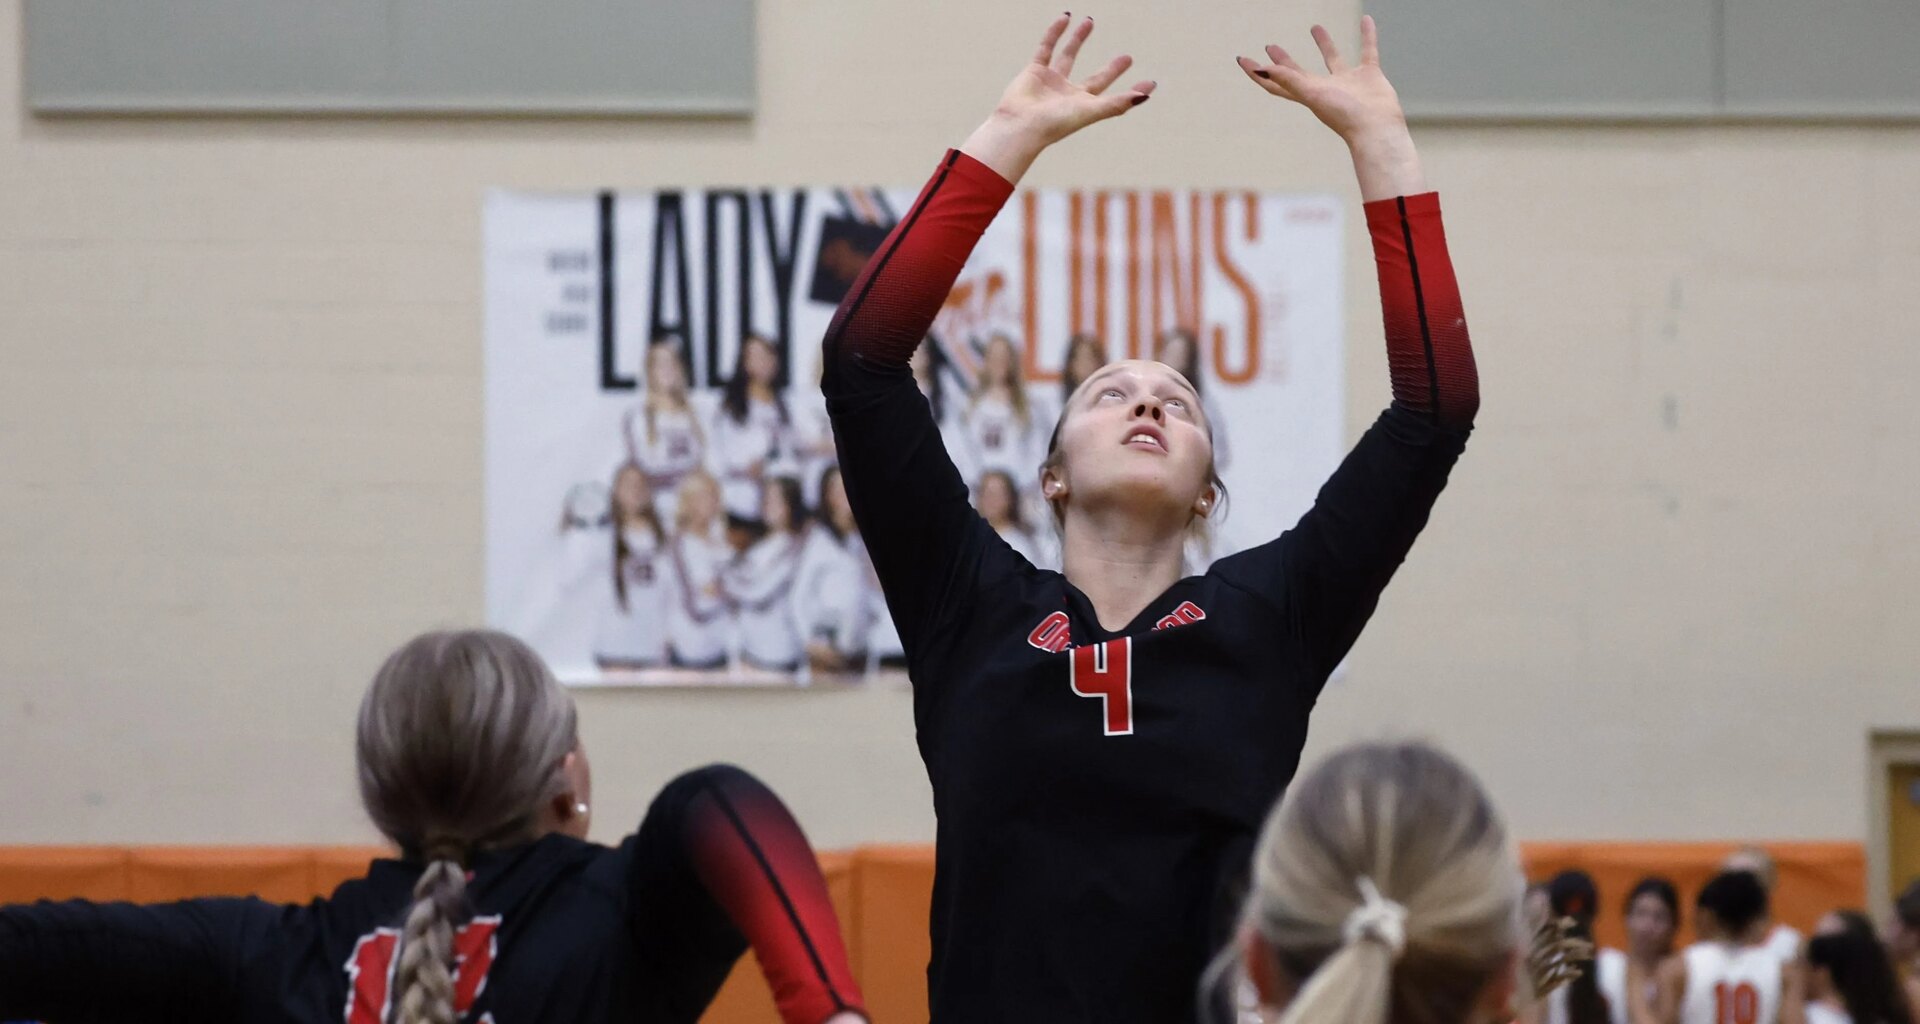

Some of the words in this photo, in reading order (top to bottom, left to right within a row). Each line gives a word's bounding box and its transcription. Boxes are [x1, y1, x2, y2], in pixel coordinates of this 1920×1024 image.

[597, 190, 805, 389] LADY
[1021, 190, 1261, 387] LIONS
[1069, 635, 1134, 736] 4
[1713, 980, 1759, 1024] 10
